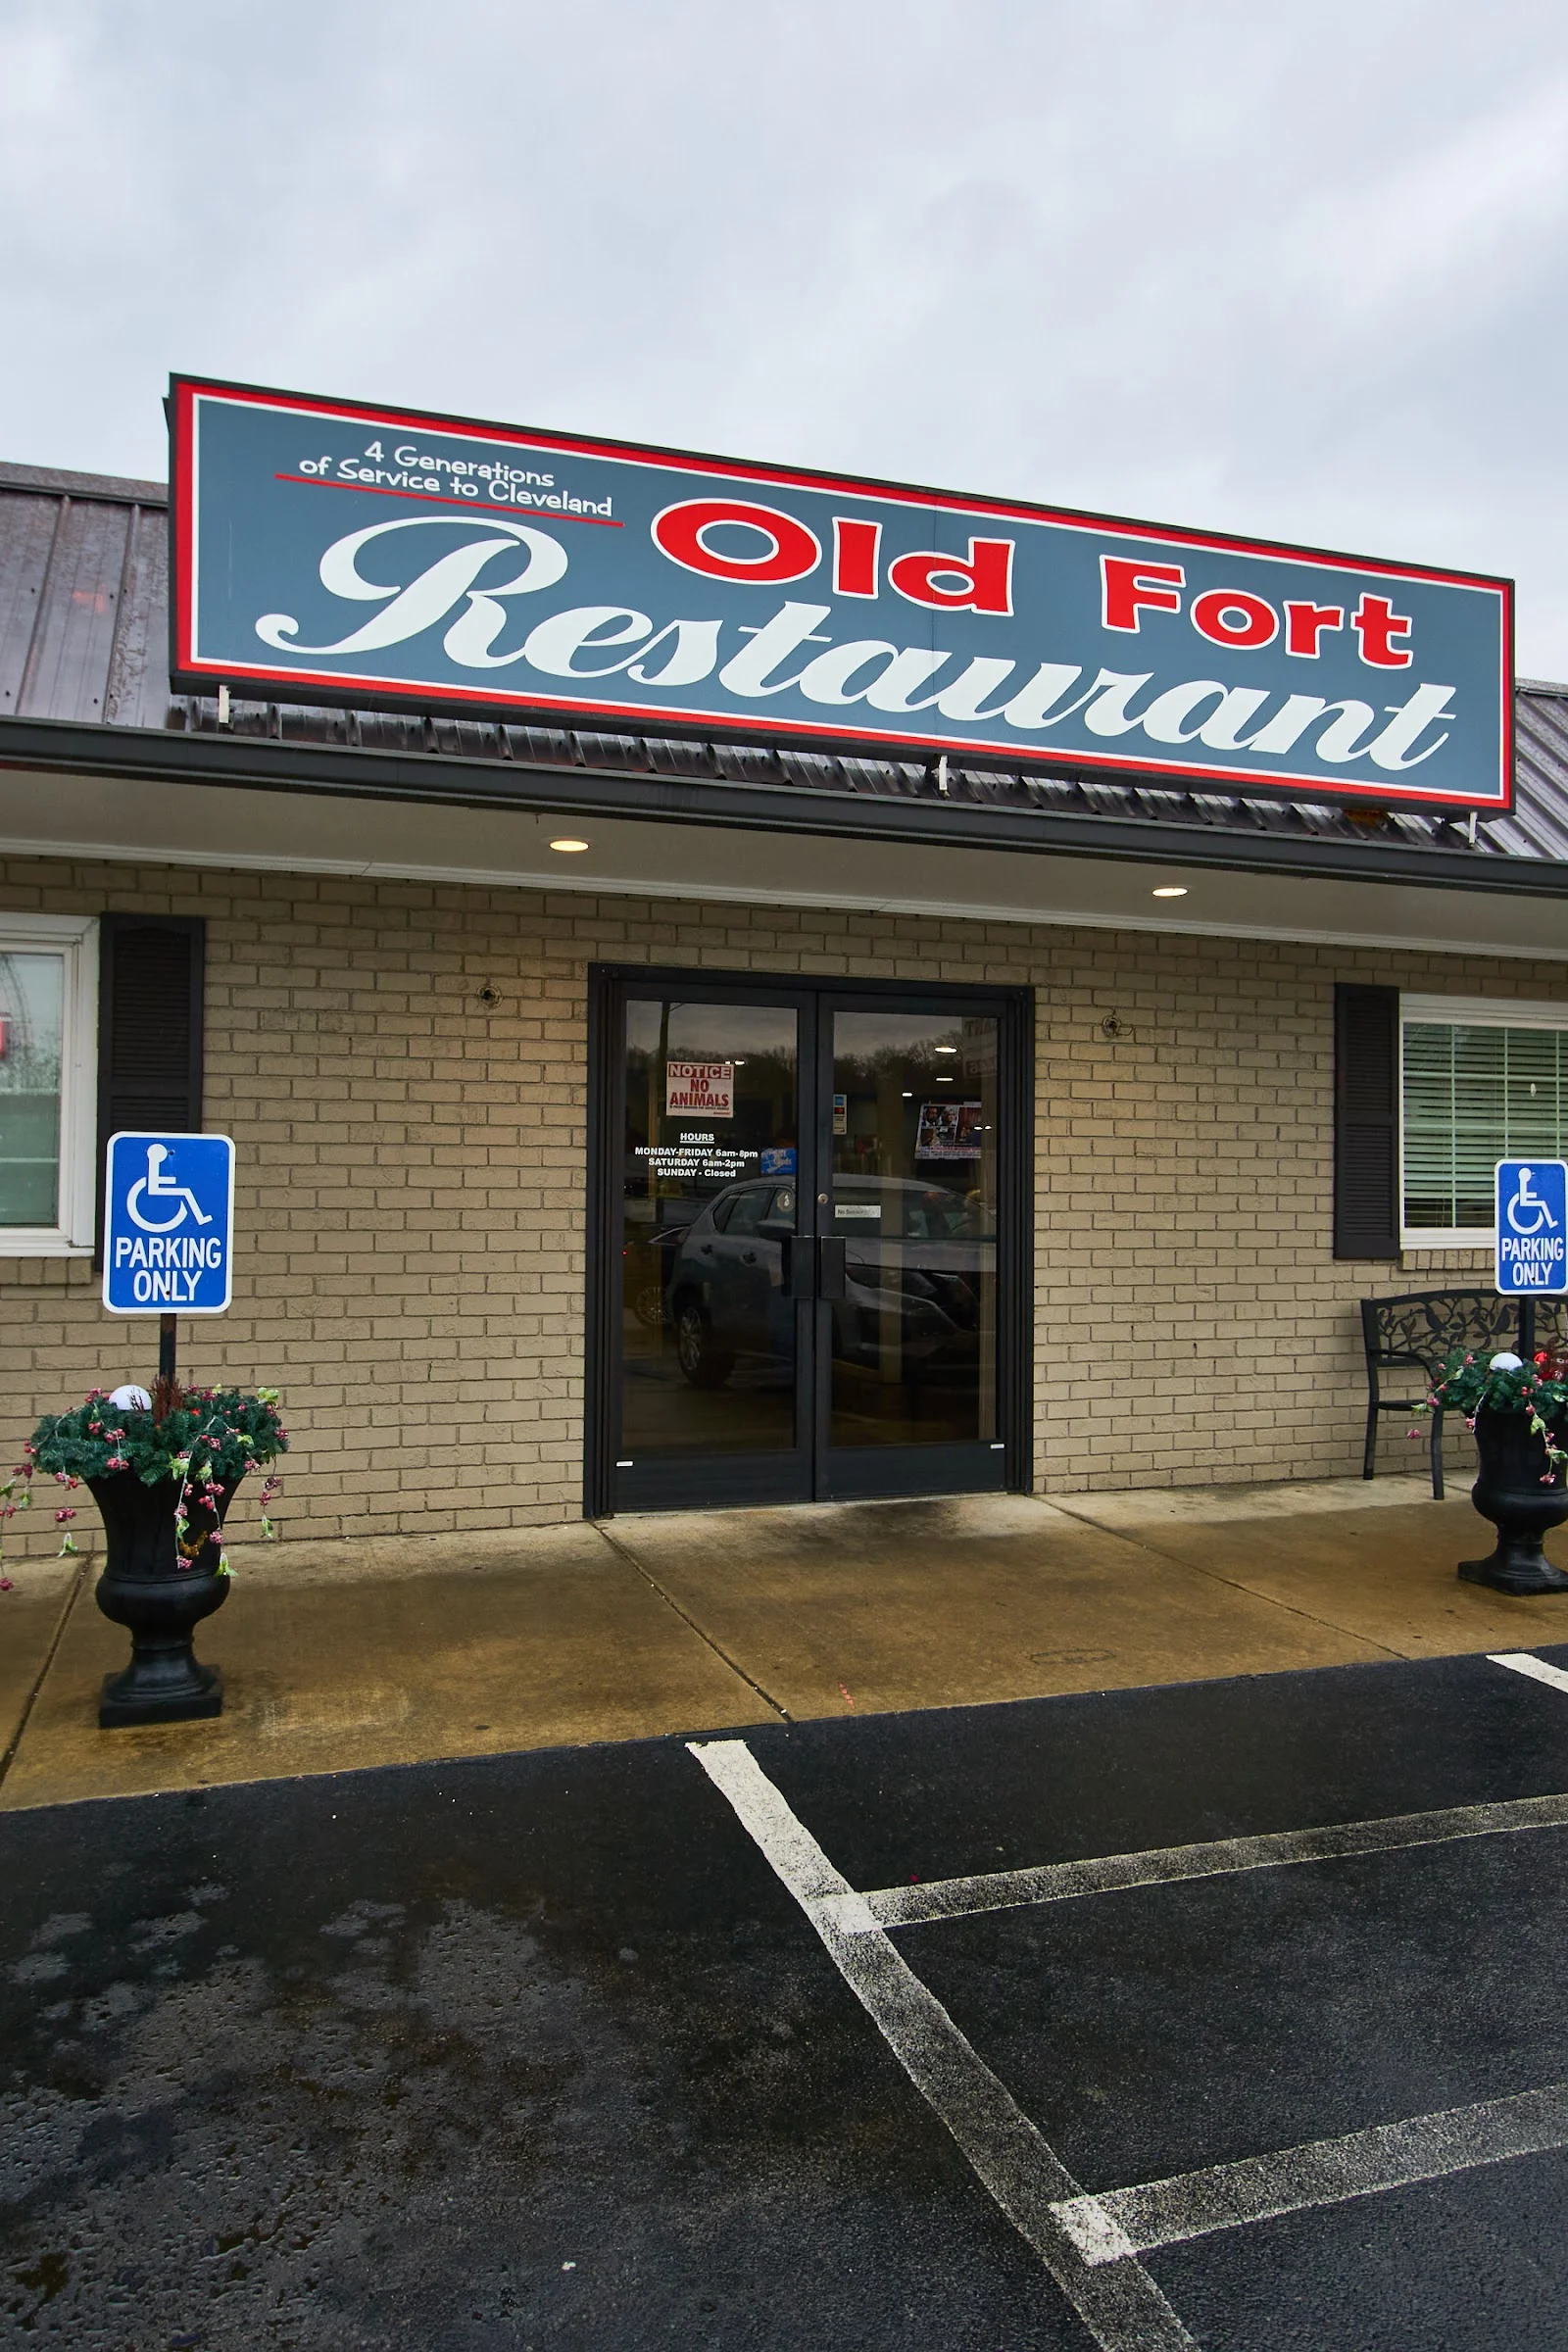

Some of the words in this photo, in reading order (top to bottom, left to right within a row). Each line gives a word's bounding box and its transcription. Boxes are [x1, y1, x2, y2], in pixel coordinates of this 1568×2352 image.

[365, 441, 384, 463] 4
[394, 446, 555, 487] Generations
[299, 456, 331, 475] of
[336, 458, 440, 491] Service
[450, 476, 478, 497] to
[489, 480, 612, 516] Cleveland
[651, 498, 1015, 616] Old
[1099, 555, 1413, 670] Fort
[255, 516, 1456, 771] Restaurant
[669, 1064, 730, 1078] NOTICE
[691, 1079, 710, 1092] NO
[670, 1092, 729, 1106] ANIMALS
[680, 1133, 714, 1143] HOURS
[635, 1147, 713, 1157] MONDAY-FRIDAY
[649, 1157, 701, 1167] SATURDAY
[703, 1159, 745, 1168] 6am-2pm
[116, 1237, 221, 1269] PARKING
[1501, 1238, 1564, 1261] PARKING
[133, 1270, 203, 1301] ONLY
[1513, 1262, 1552, 1286] ONLY
